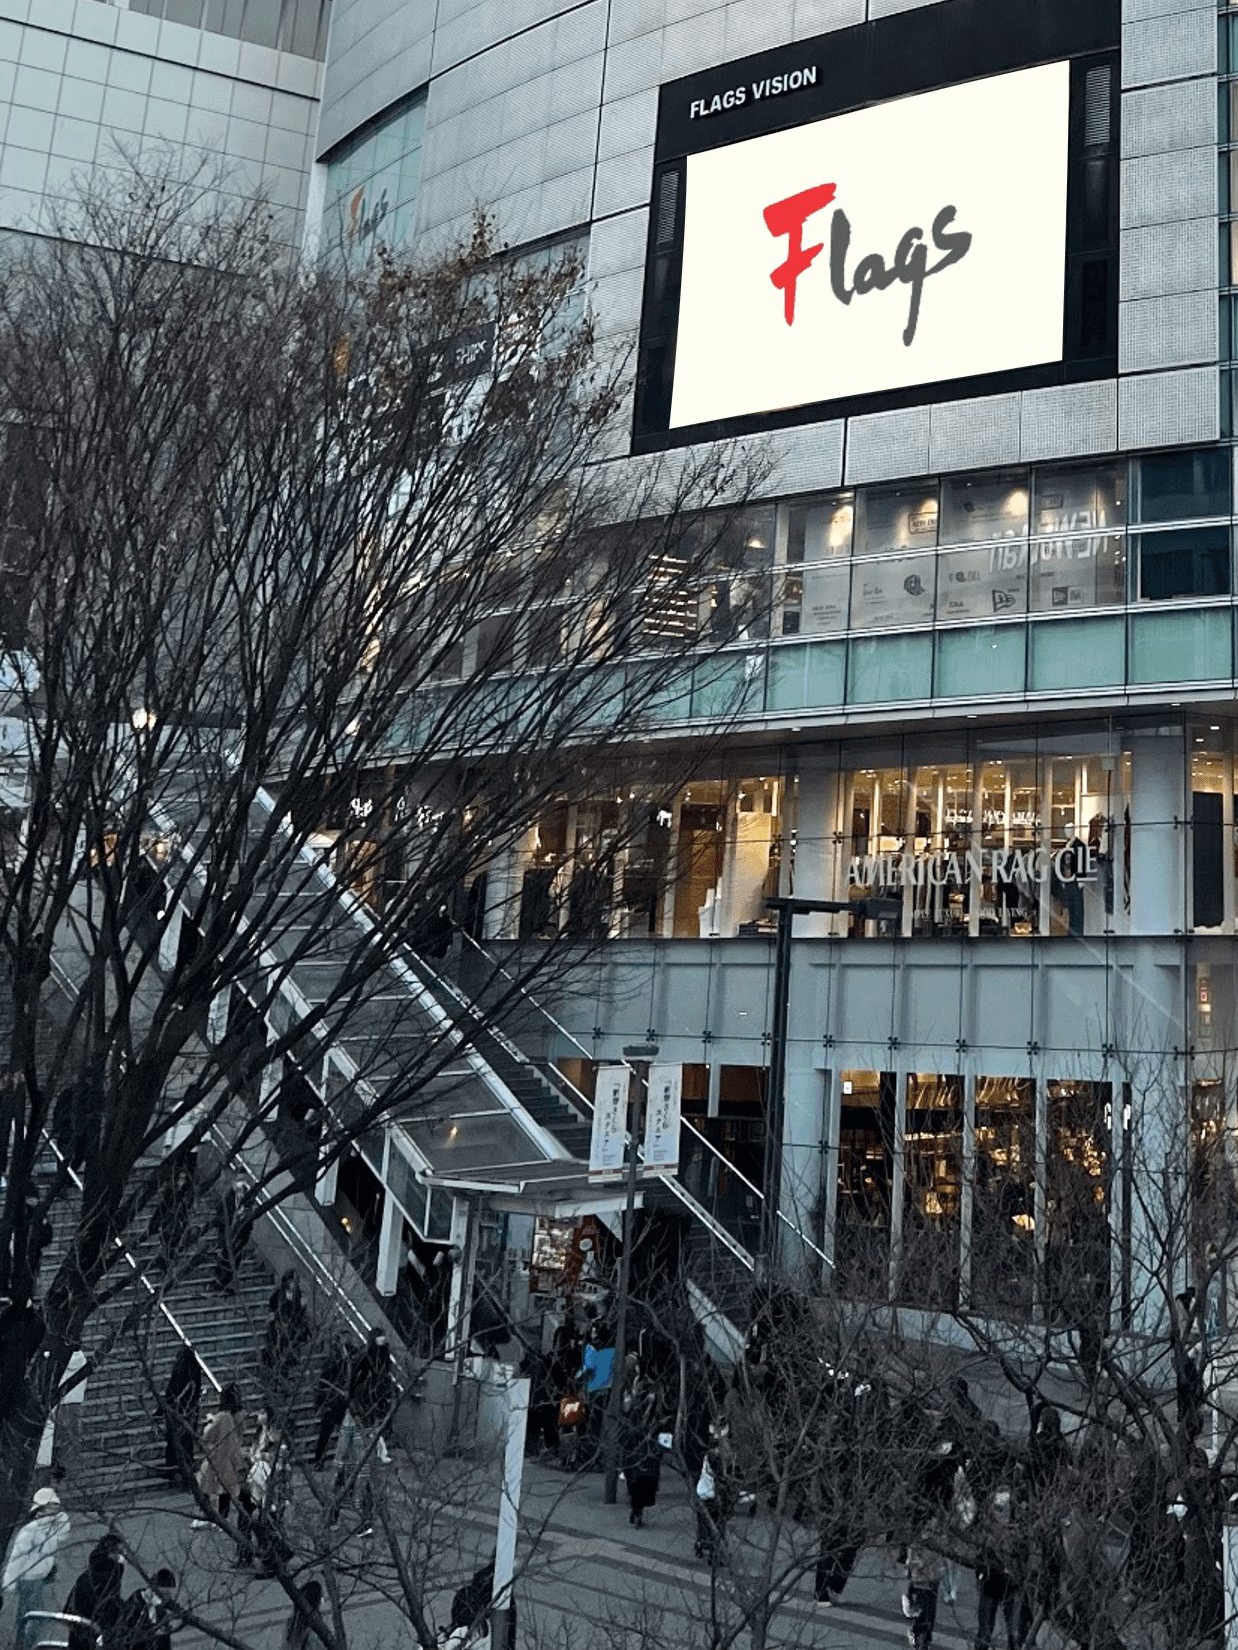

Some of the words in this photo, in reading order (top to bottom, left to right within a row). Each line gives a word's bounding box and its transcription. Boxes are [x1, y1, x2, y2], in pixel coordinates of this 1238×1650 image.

[690, 87, 747, 120] FLAGS
[751, 65, 818, 102] VISION
[762, 181, 973, 348] Flags
[846, 849, 984, 886] AMERICAN
[991, 847, 1049, 884] RAG
